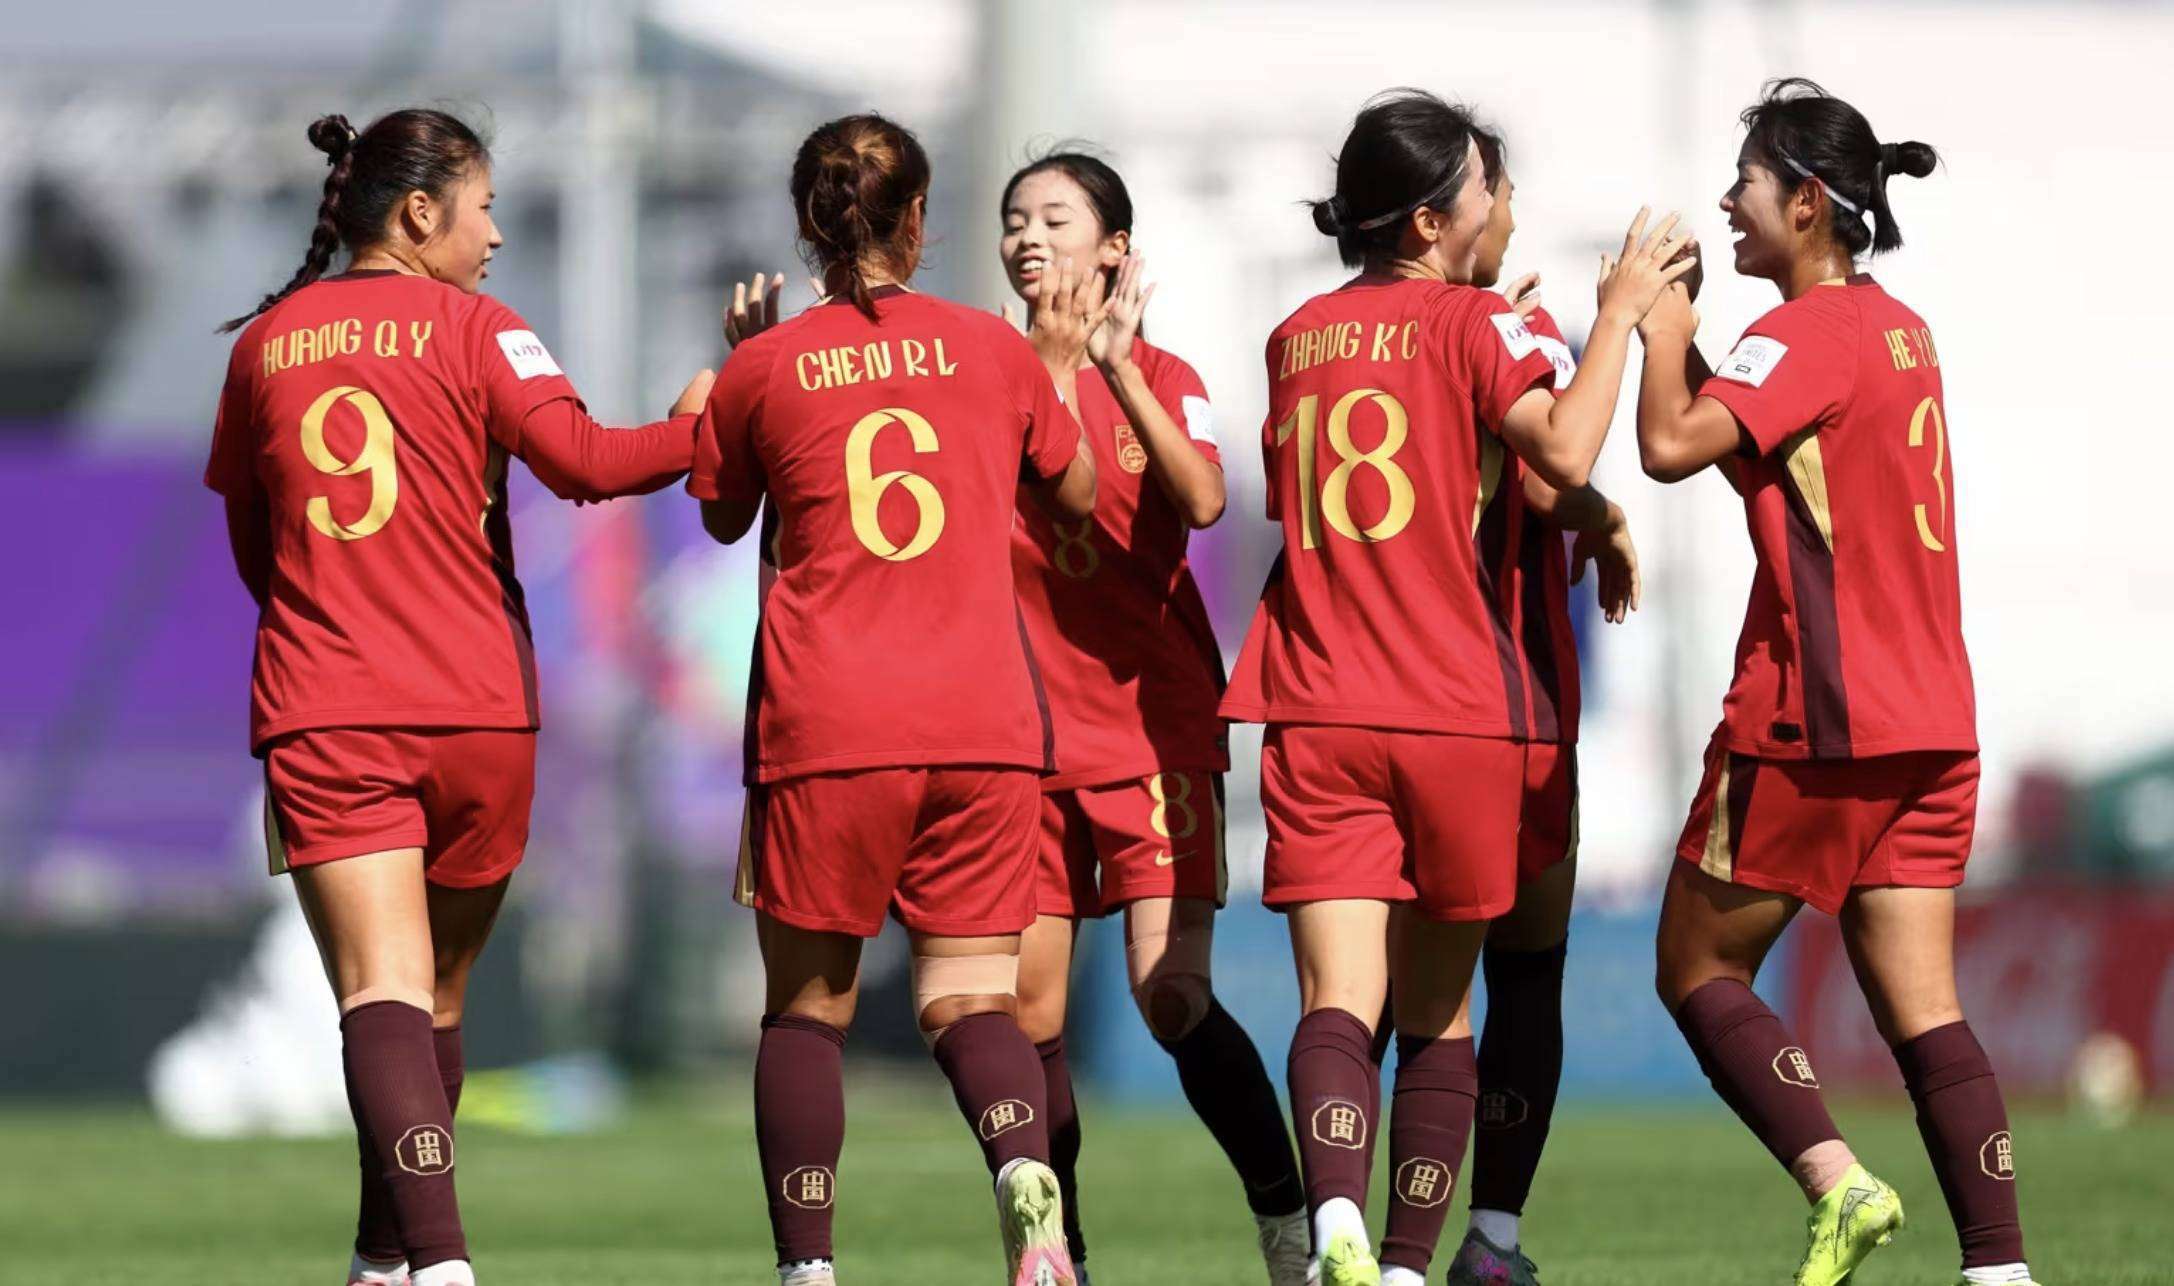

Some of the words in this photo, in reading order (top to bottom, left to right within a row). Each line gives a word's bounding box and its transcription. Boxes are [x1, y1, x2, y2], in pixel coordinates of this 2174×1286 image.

[263, 318, 362, 377] HUANG
[374, 319, 400, 358] Q
[410, 321, 433, 358] Y
[796, 339, 893, 392] CHEN
[901, 339, 930, 377] R
[934, 338, 958, 377] L
[1279, 321, 1362, 381] ZHANG
[1370, 321, 1398, 363] K
[1400, 320, 1419, 360] C
[1884, 328, 1917, 371] HE
[300, 386, 398, 541] 9
[845, 407, 945, 561] 6
[1277, 388, 1416, 550] 18
[1908, 396, 1946, 552] 3
[1052, 517, 1099, 578] 8
[1150, 772, 1198, 839] 8
[414, 1131, 442, 1167] 中国
[1330, 1106, 1356, 1142] 中国
[1408, 1164, 1439, 1200] 中国
[1996, 1137, 2012, 1172] 中国
[802, 1171, 824, 1201] 中国
